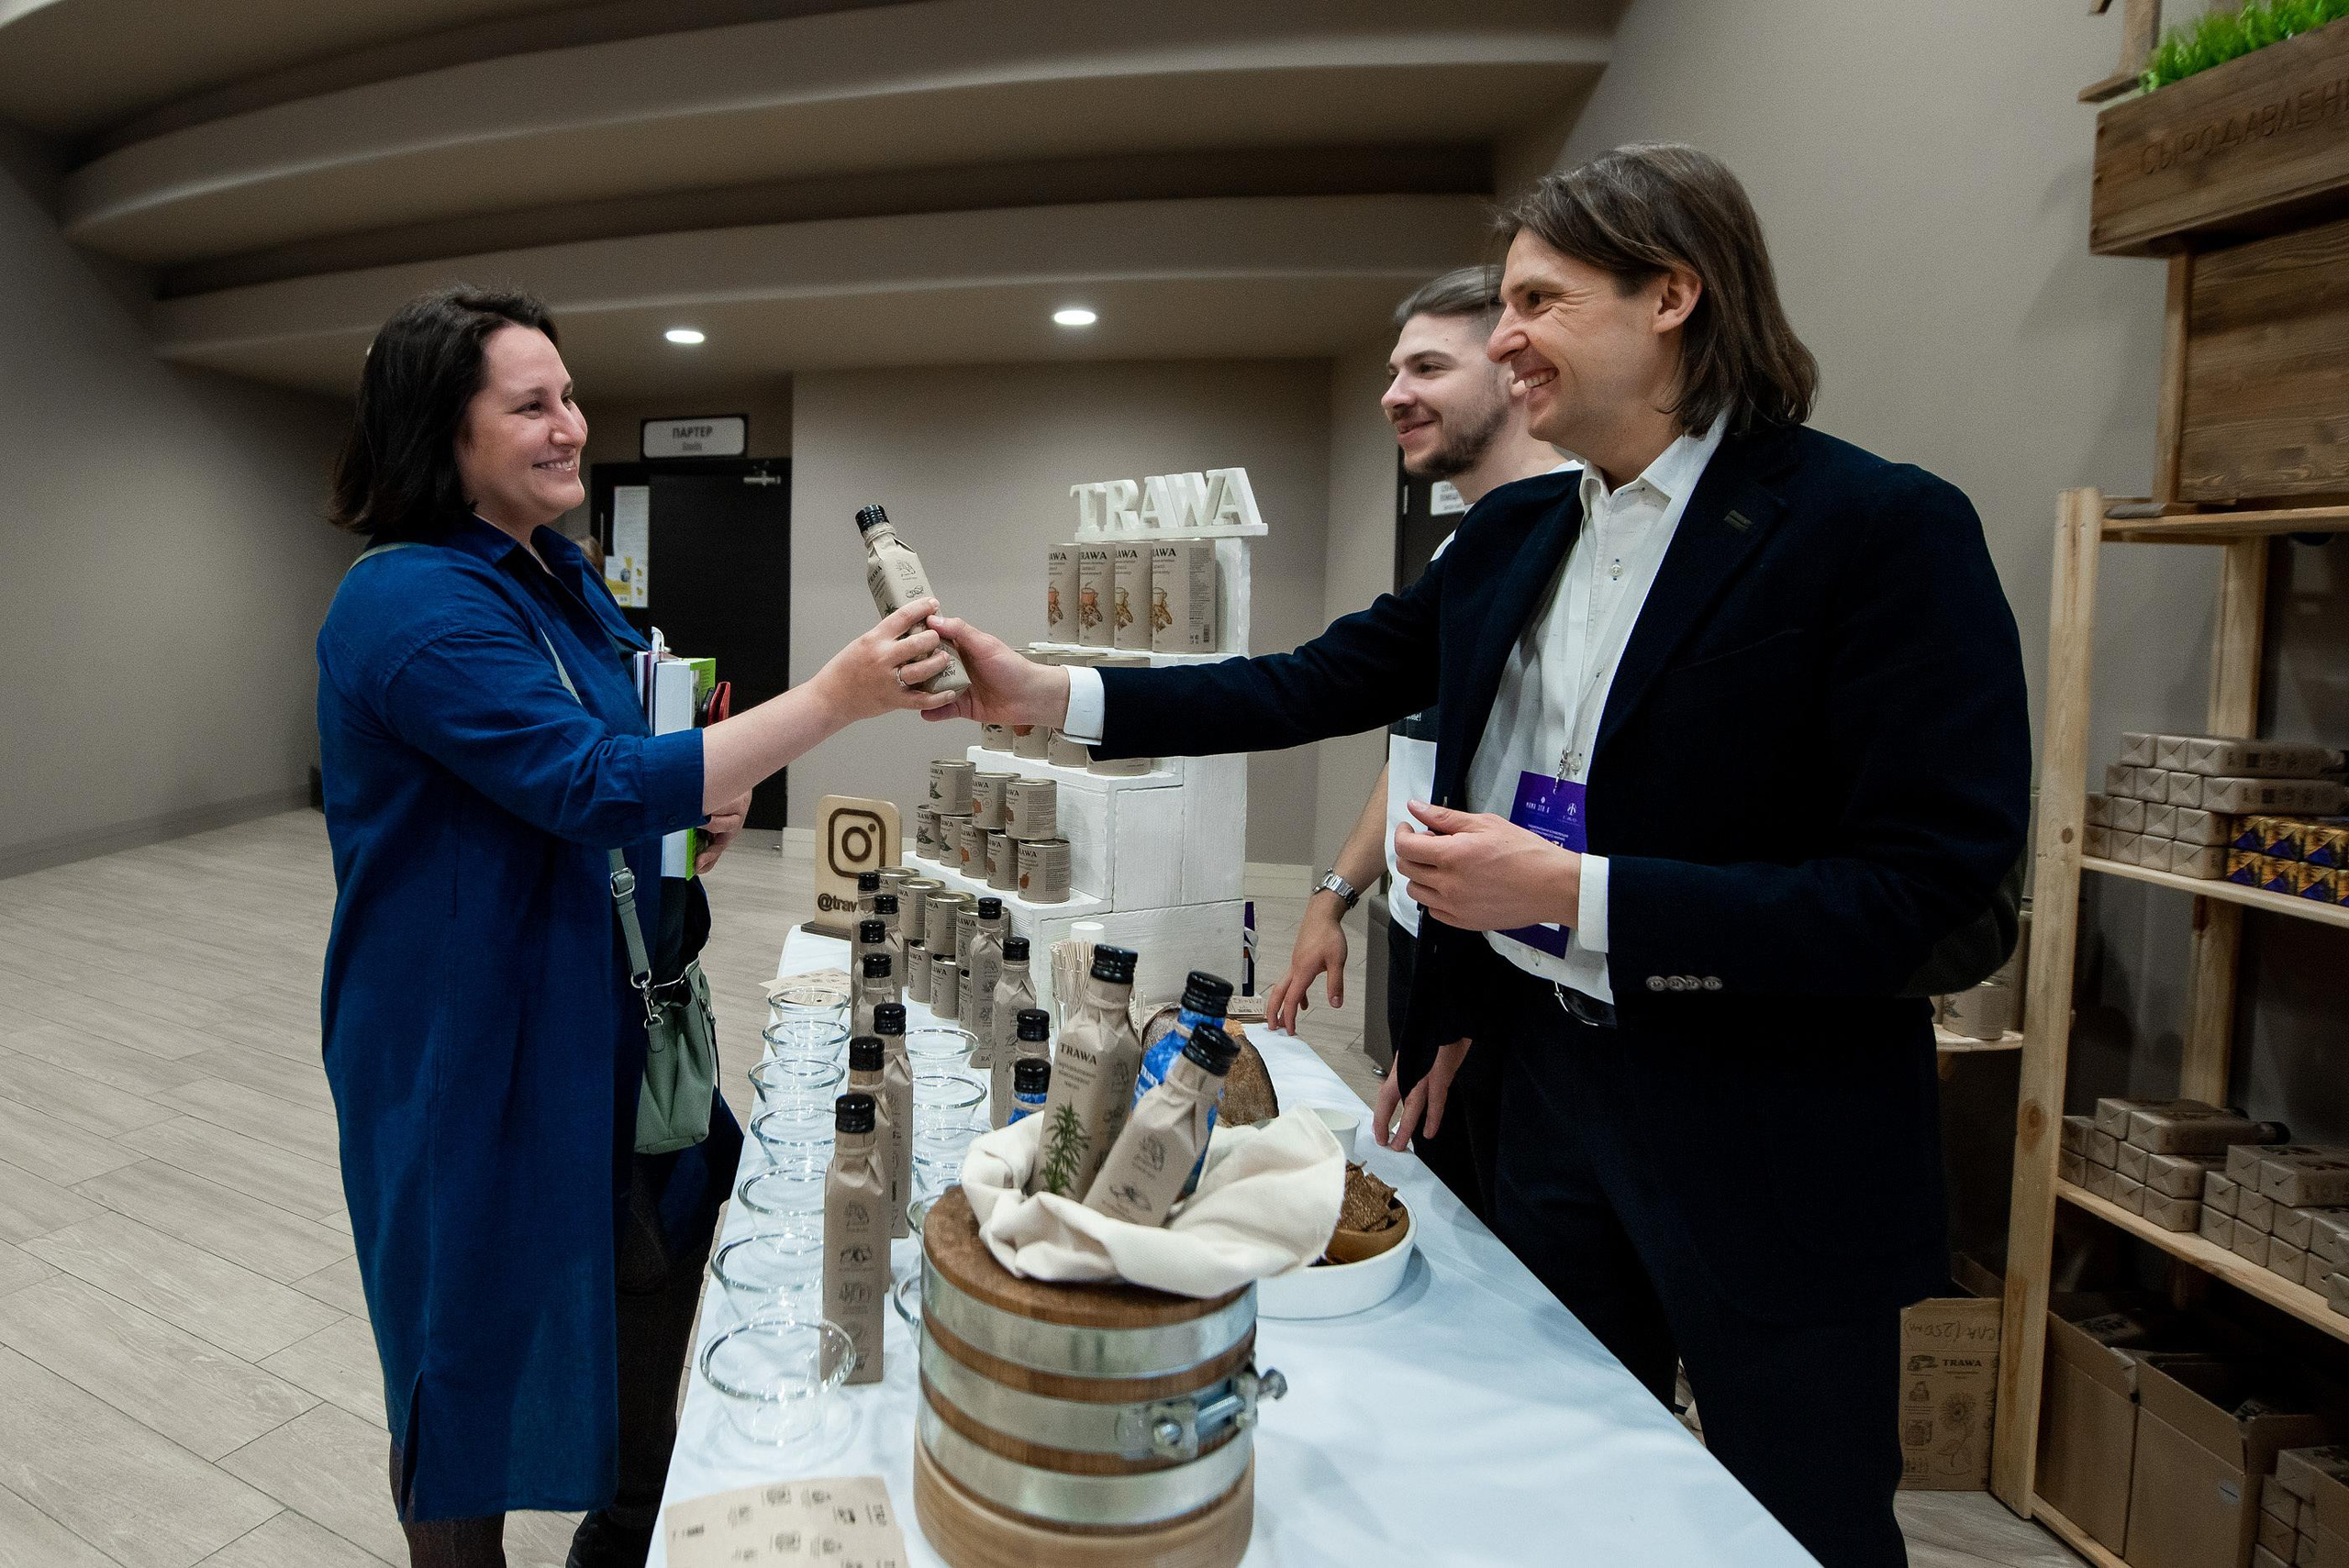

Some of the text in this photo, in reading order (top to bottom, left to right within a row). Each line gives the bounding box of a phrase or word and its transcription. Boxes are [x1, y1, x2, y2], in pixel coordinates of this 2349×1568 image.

[673, 426, 713, 439] ПАРТЕР
[1070, 467, 1263, 532] TRAWA
[818, 893, 858, 913] @trav
[1060, 1041, 1097, 1066] TRAWA
[1942, 1358, 1983, 1368] TRAWA
